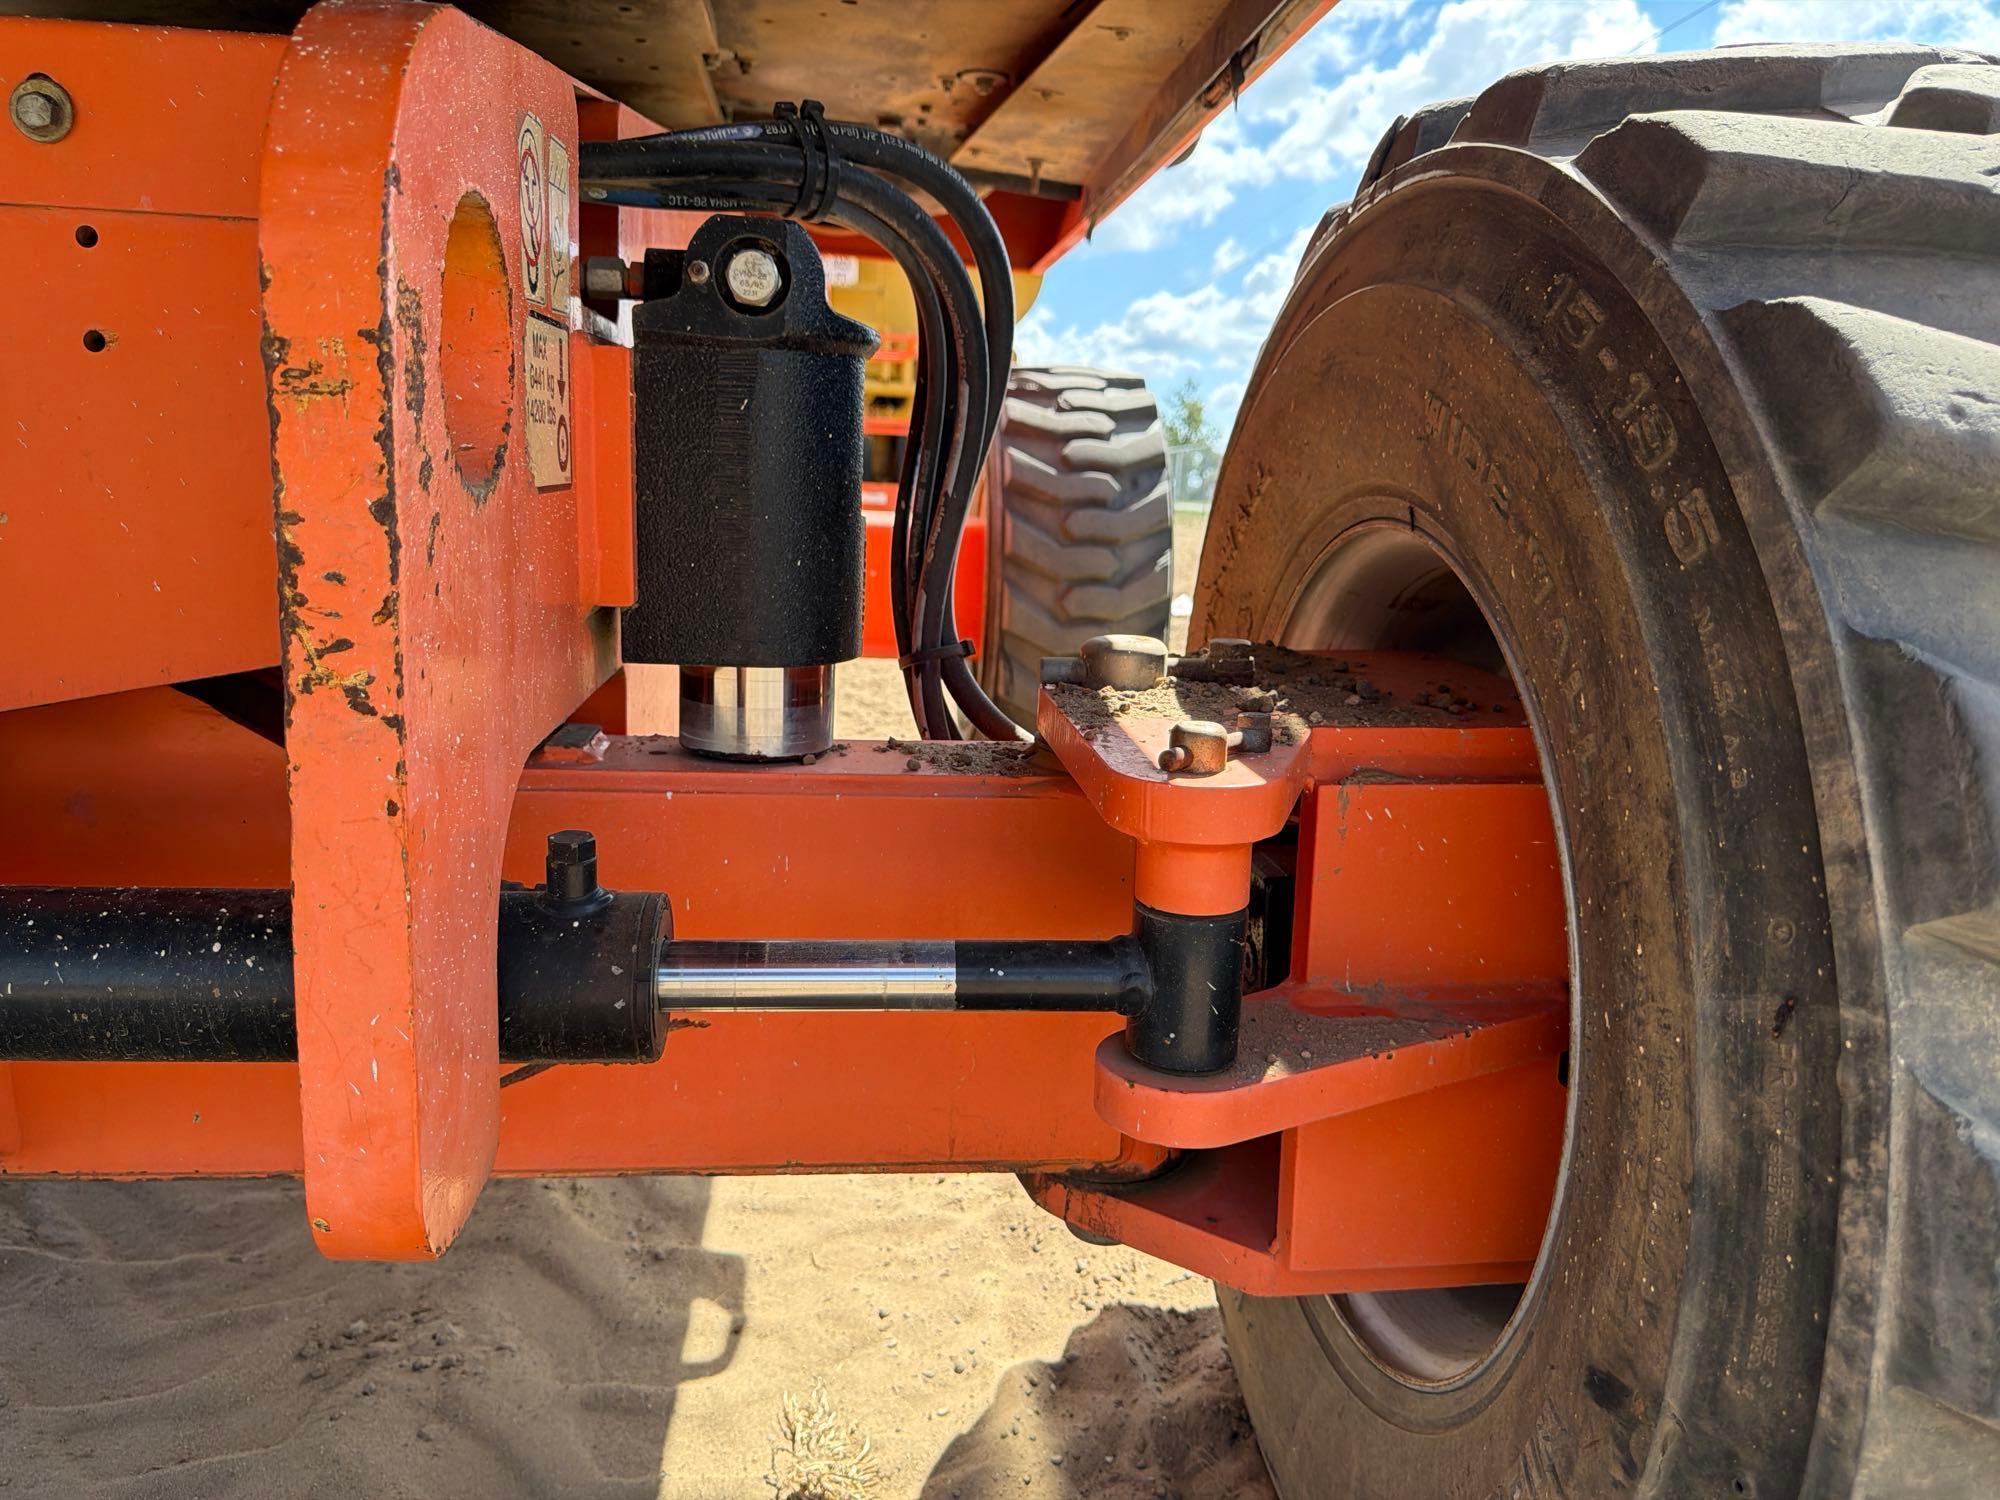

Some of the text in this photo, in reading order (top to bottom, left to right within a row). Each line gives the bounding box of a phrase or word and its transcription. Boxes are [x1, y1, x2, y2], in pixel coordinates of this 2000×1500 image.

[532, 331, 549, 361] MAX
[546, 366, 555, 400] kg
[547, 399, 557, 426] lbs
